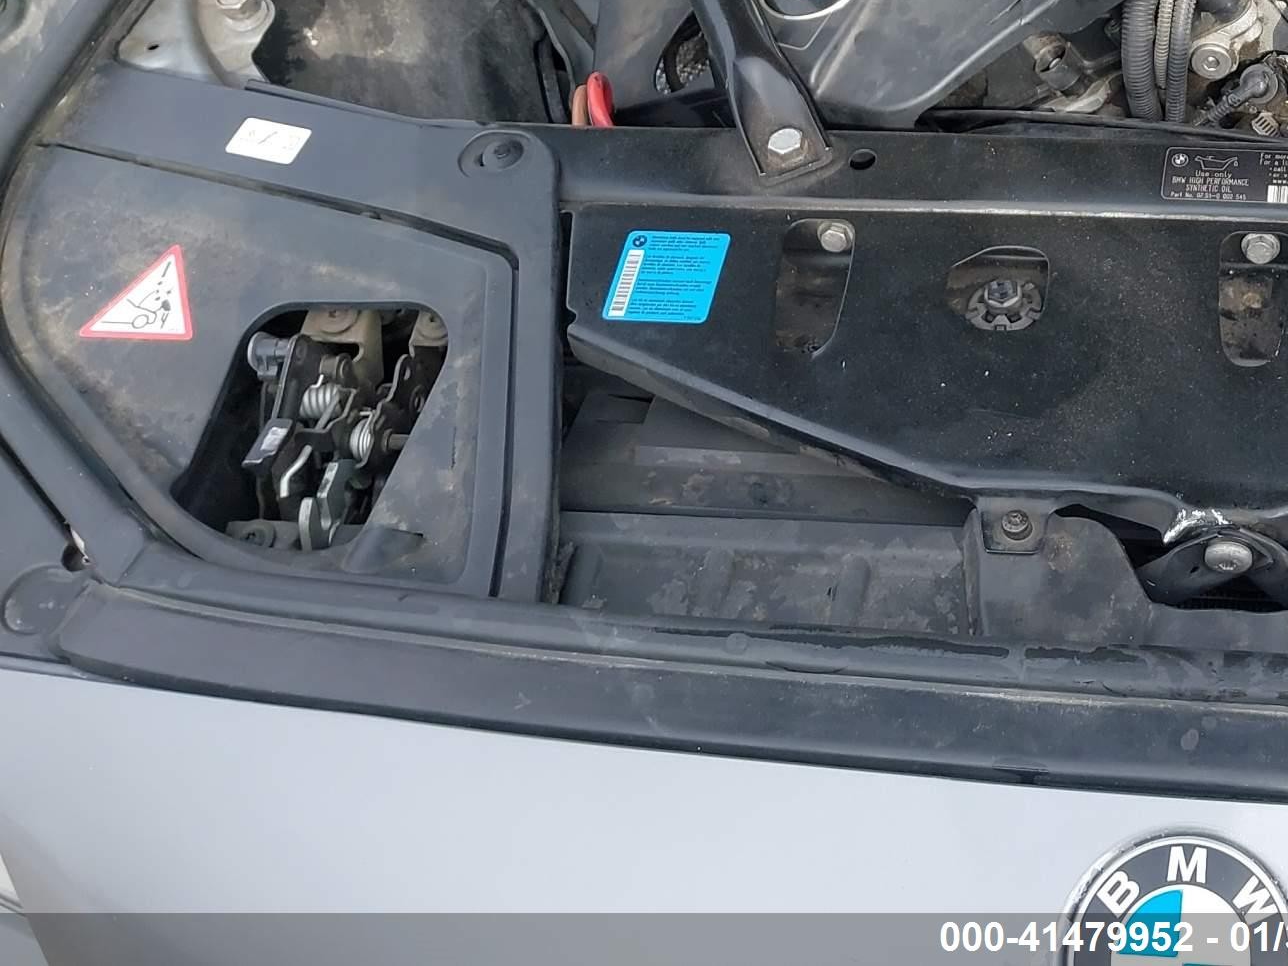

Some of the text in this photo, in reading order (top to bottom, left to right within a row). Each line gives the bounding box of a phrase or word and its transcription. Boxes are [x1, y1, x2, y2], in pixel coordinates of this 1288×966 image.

[1214, 170, 1232, 179] only
[1172, 176, 1249, 187] BMW HIGH PERFORMANCE
[1186, 184, 1232, 193] SYNTHETIC OIL
[1097, 846, 1280, 926] BMW
